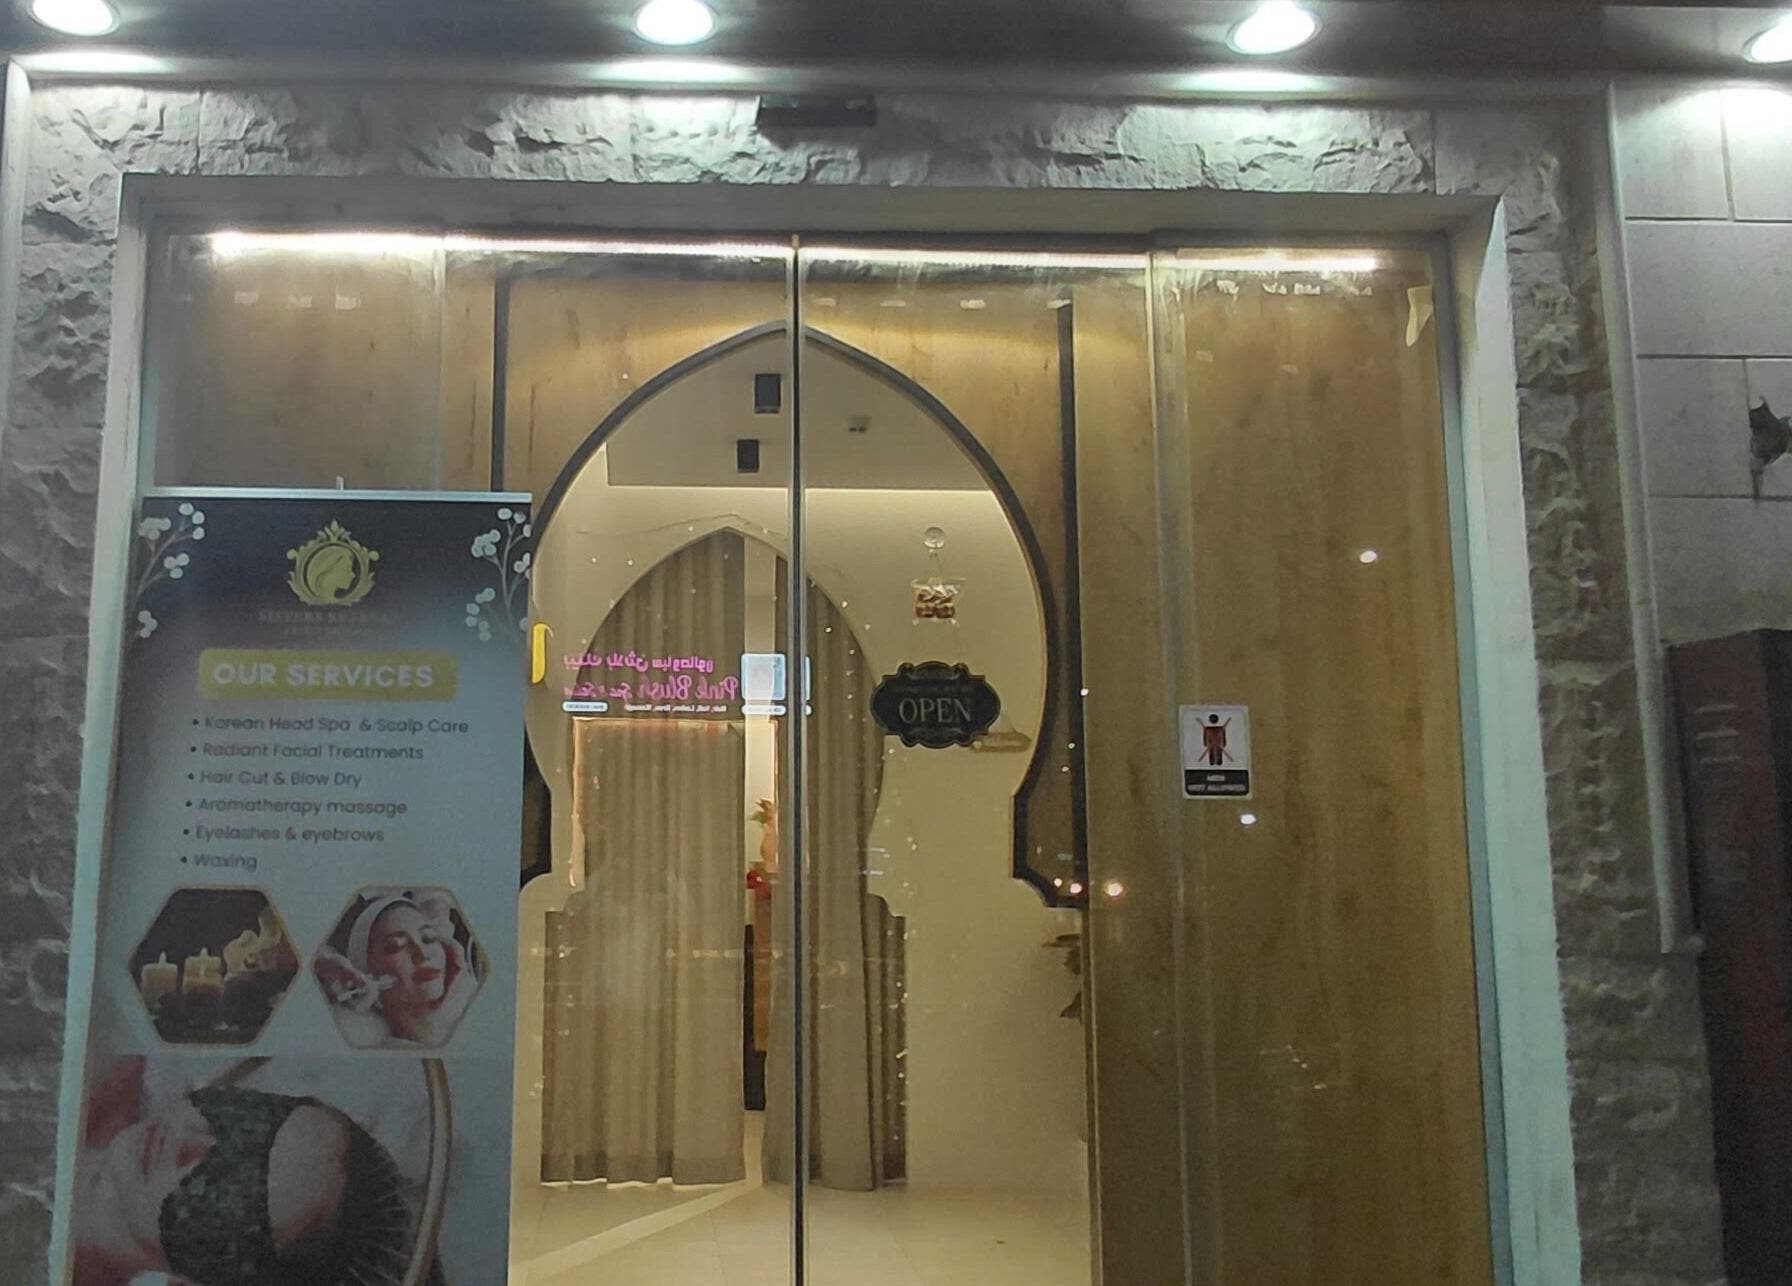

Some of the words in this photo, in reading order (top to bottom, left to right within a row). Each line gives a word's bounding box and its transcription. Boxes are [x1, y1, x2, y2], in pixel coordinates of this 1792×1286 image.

[213, 663, 277, 686] OUR
[287, 663, 434, 688] SERVICES
[899, 697, 972, 724] OPEN
[205, 716, 263, 730] Korean
[270, 717, 313, 731] Head
[319, 717, 350, 735] Spa
[359, 719, 372, 732] &
[377, 718, 423, 735] Scalp
[428, 719, 469, 733] Care
[203, 743, 268, 757] Radiant
[274, 744, 322, 758] Facial
[327, 744, 424, 759] Treatments
[200, 772, 233, 785] Hair
[237, 772, 269, 785] Cut
[273, 773, 286, 785] &
[291, 772, 328, 786] Blow
[334, 773, 362, 788] Dry
[199, 798, 321, 816] Aromatherapy
[327, 801, 407, 817] massage
[196, 826, 280, 842] Eyelashes
[284, 827, 297, 841] &
[302, 827, 385, 844] eyebrows
[194, 854, 257, 872] Waxing
